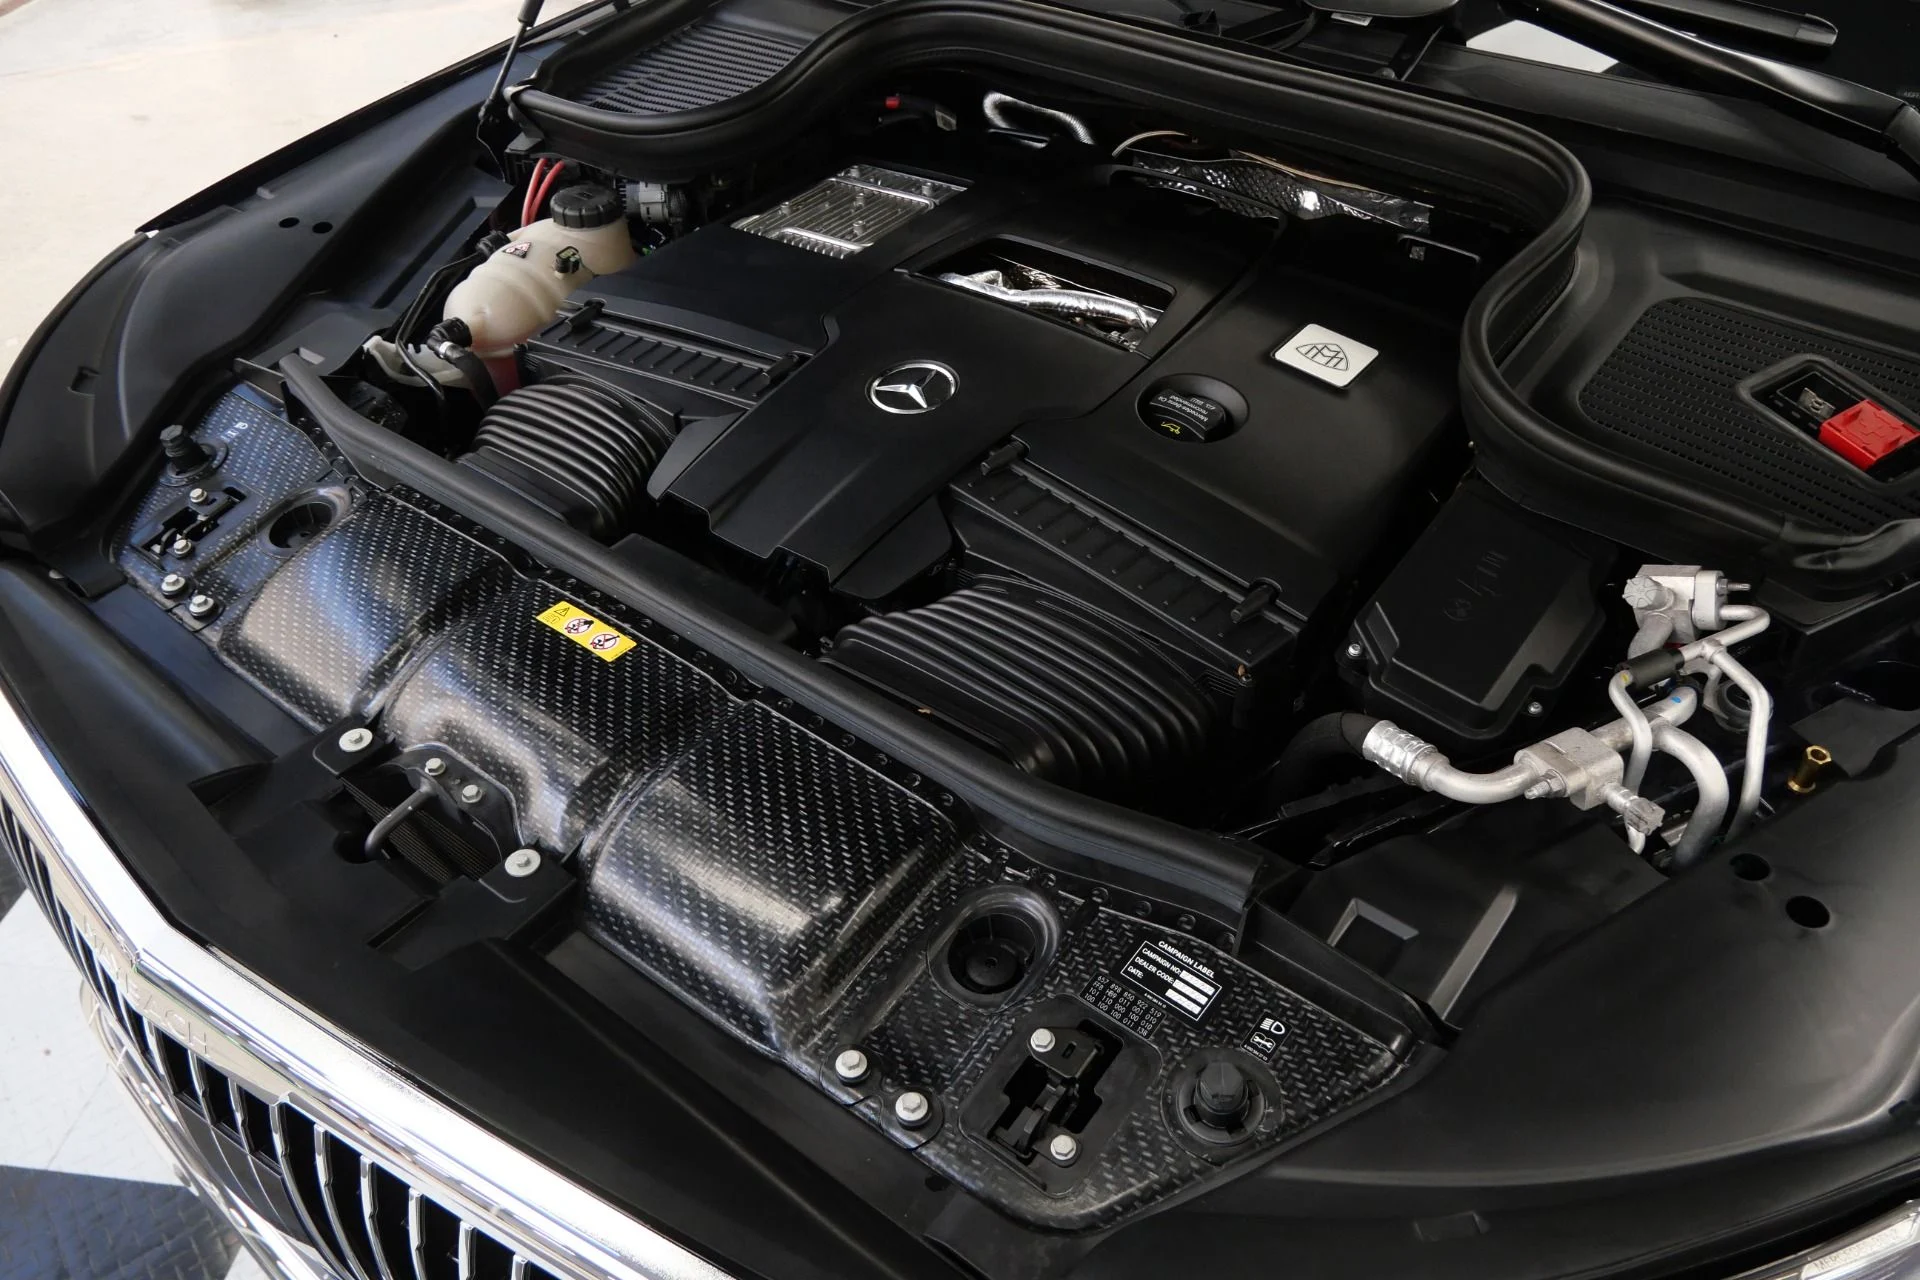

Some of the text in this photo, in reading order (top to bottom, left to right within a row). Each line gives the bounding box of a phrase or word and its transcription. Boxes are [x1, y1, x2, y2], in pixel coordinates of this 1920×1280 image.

[1169, 395, 1208, 415] recommended
[1127, 965, 1144, 979] DATE:
[1134, 956, 1175, 984] DEALER CODE:
[1142, 947, 1182, 976] CAMPAIGN NO:
[1158, 940, 1215, 979] CAMPAIGN LABEL
[1084, 993, 1096, 1003] 100
[1110, 1009, 1122, 1020] 100
[1088, 987, 1100, 997] 101
[1101, 995, 1113, 1005] 110
[1128, 1011, 1139, 1022] 100
[1140, 1020, 1153, 1030] 010
[1097, 975, 1110, 984] 657
[1136, 1000, 1148, 1010] 922
[1149, 1007, 1162, 1018] 519
[1118, 997, 1131, 1007] 011
[1131, 1005, 1144, 1016] 001
[1144, 1013, 1157, 1024] 010
